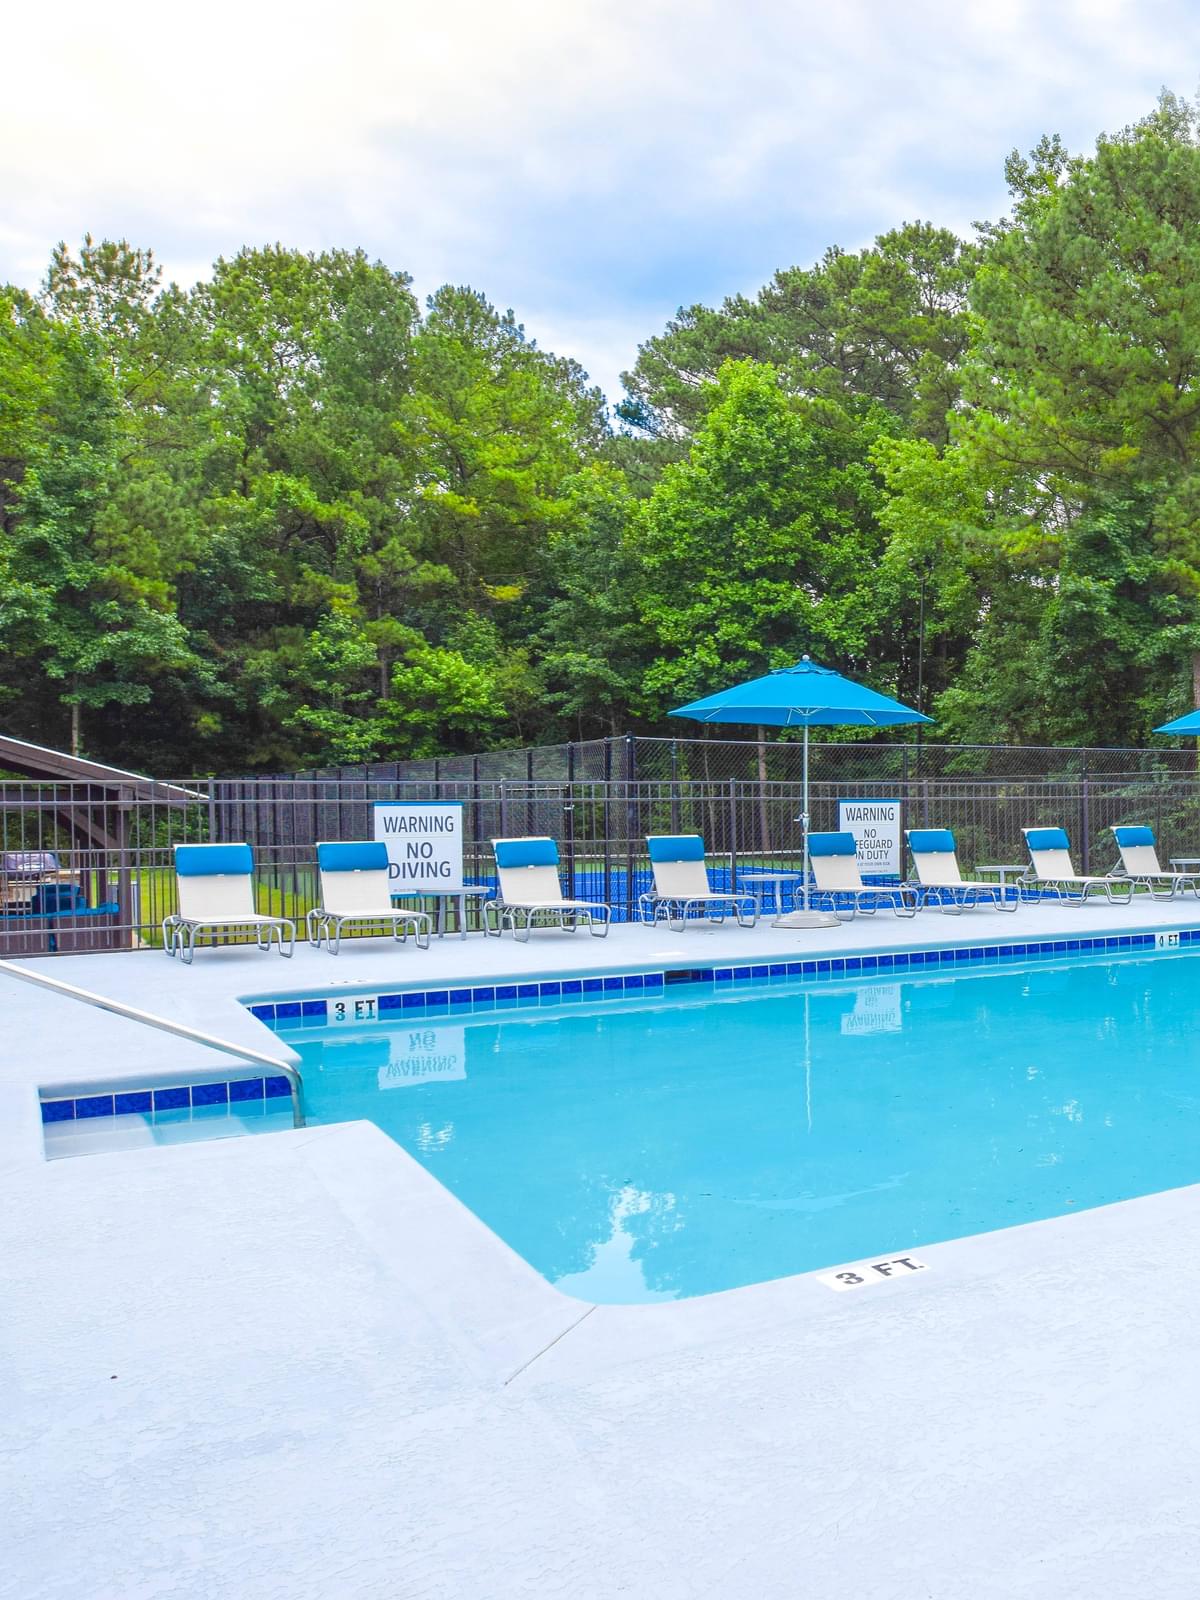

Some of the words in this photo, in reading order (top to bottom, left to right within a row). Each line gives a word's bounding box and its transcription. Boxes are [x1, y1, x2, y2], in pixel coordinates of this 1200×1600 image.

[845, 807, 895, 822] WARNING
[383, 815, 454, 833] WARNING
[863, 828, 877, 838] NO
[406, 841, 433, 859] NO
[855, 839, 893, 849] FEGUARD
[855, 850, 864, 860] N
[866, 850, 889, 860] DUTY
[388, 860, 451, 879] DIVING
[835, 1272, 864, 1285] 3
